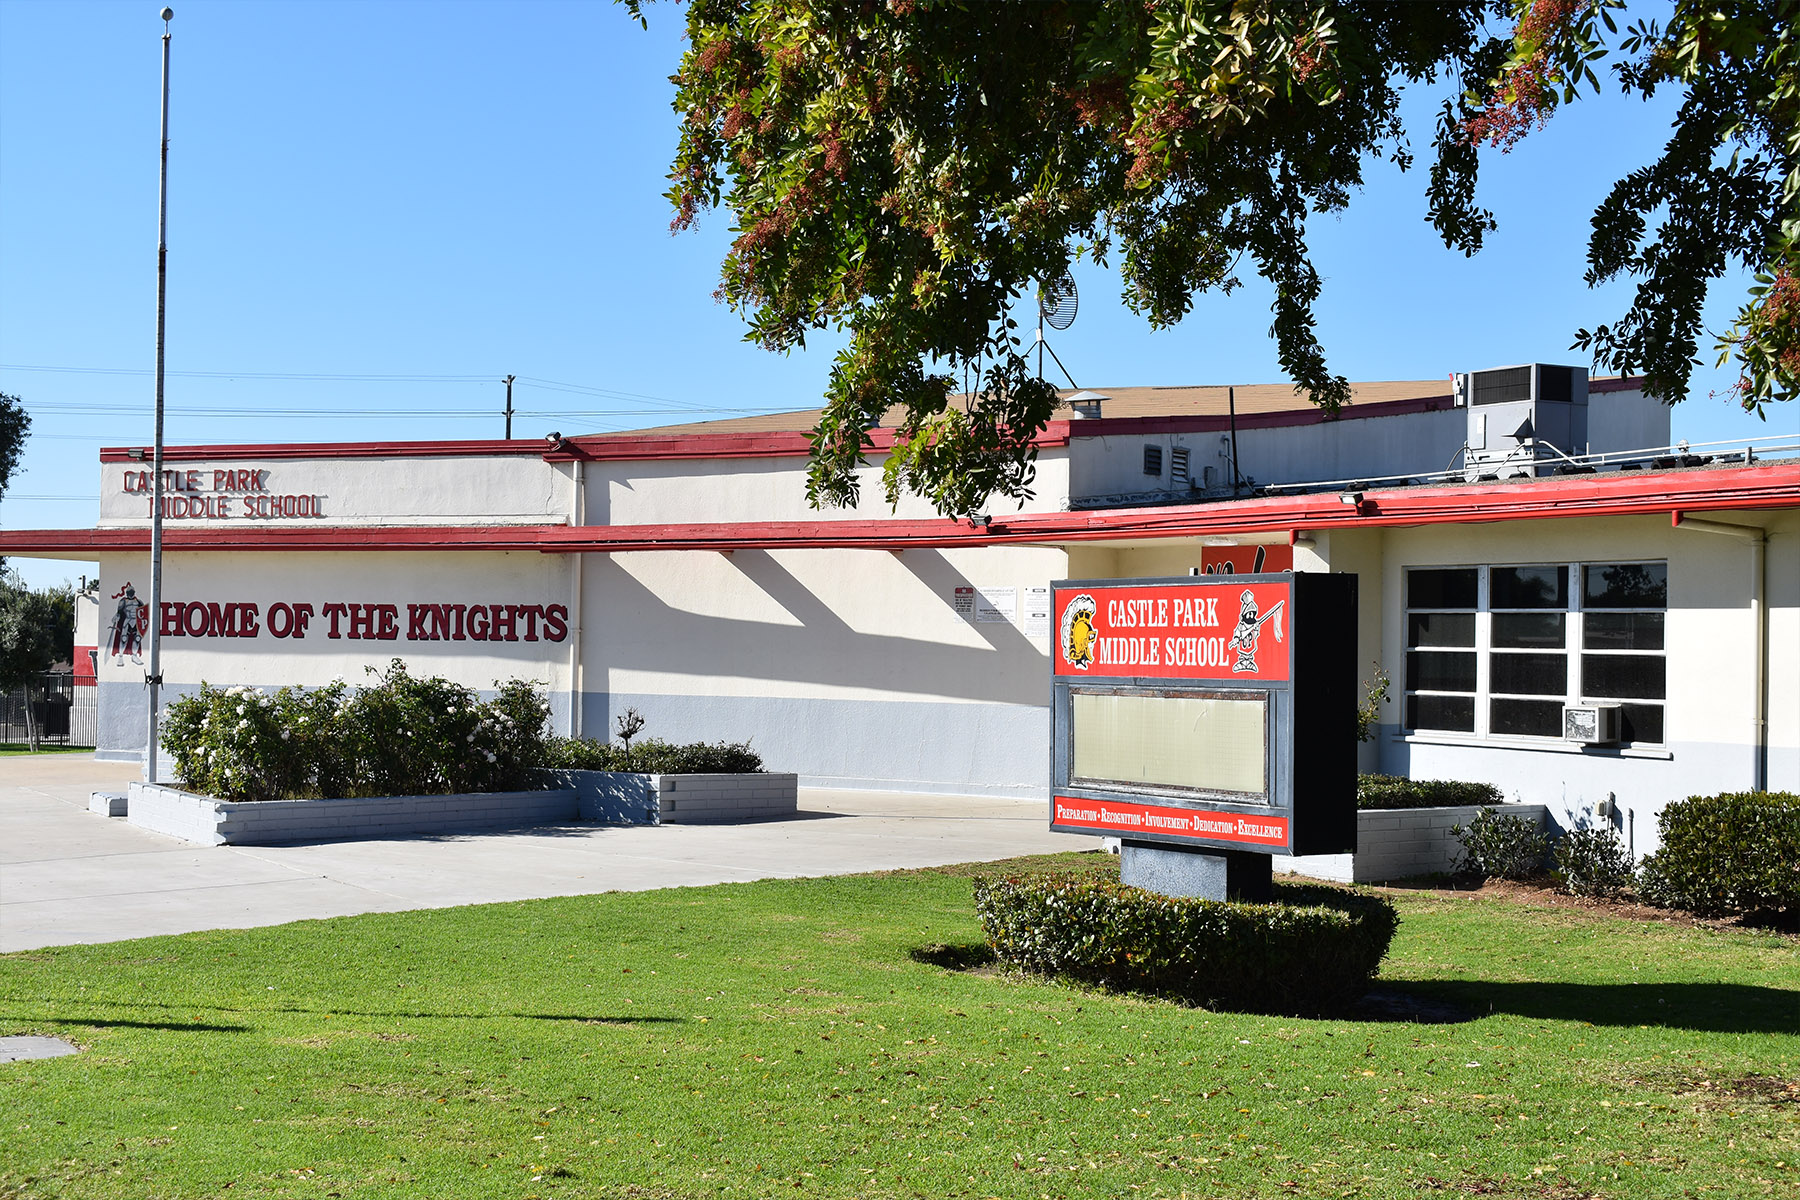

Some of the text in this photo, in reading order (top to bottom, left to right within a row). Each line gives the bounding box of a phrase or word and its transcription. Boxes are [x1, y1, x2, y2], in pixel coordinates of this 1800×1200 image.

[214, 469, 263, 491] PARK
[244, 494, 322, 517] SCHOOL
[160, 601, 569, 643] HOME OF THE KNIGHTS
[1108, 598, 1220, 628] CASTLE PARK
[1099, 637, 1230, 667] MIDDLE SCHOOL
[1057, 804, 1283, 839] PREPARATION RECOGNITION INVOLVEMENT DEDICATION EXCELLENCE
